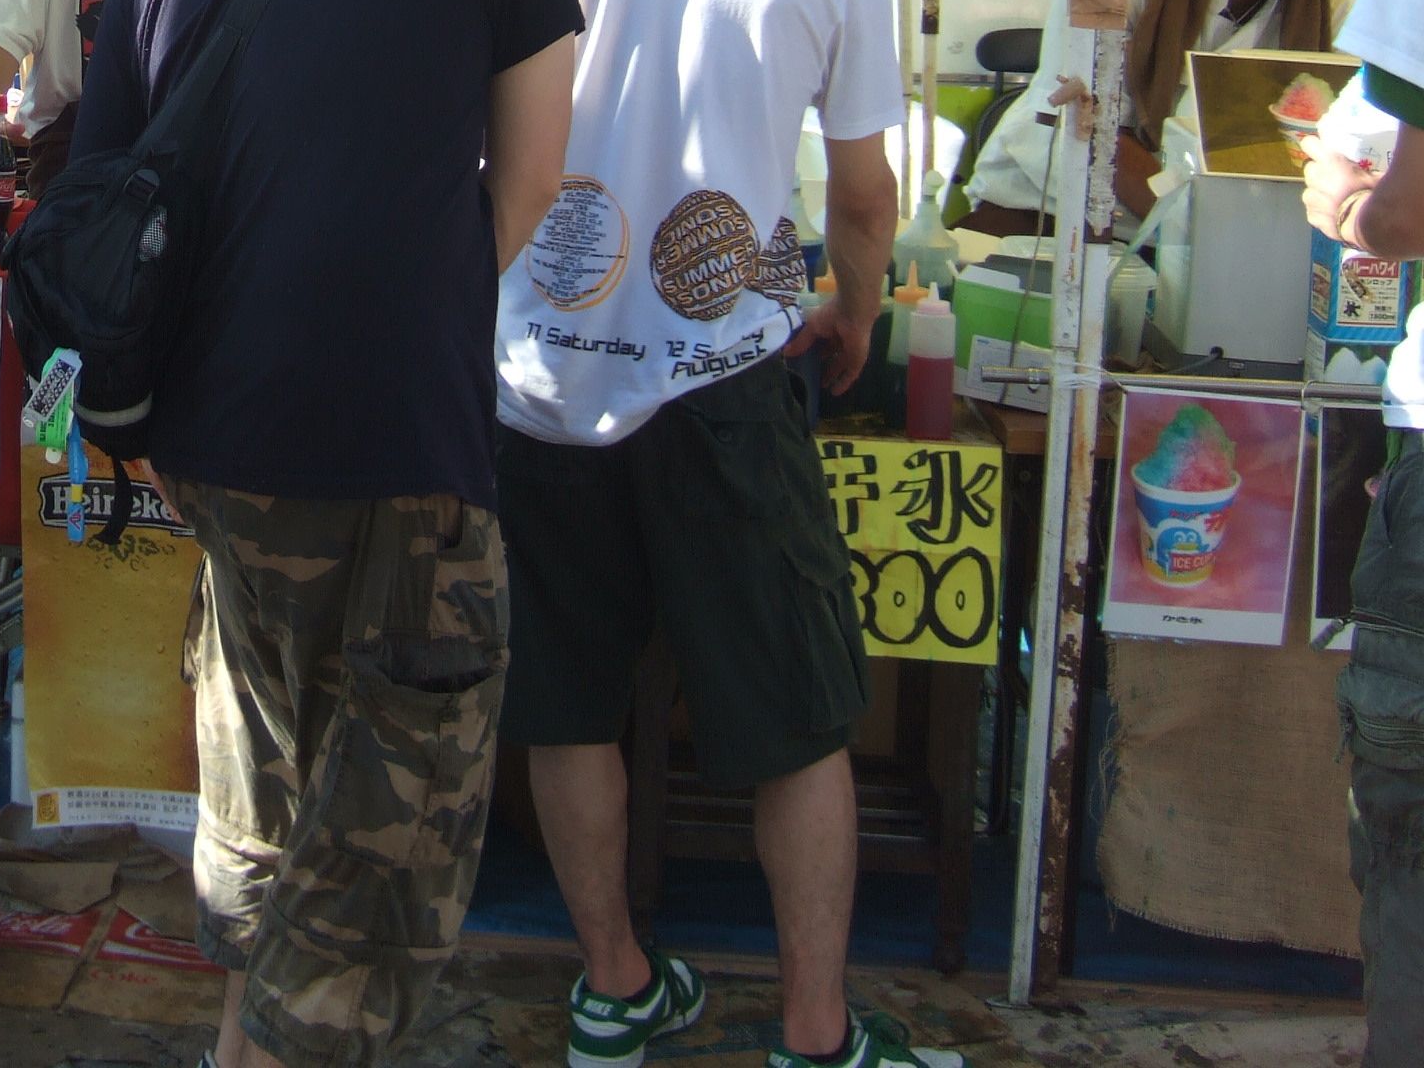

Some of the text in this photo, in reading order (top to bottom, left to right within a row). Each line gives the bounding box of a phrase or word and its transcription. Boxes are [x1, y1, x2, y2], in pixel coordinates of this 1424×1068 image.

[662, 241, 756, 294] SUMMER
[544, 327, 647, 362] Saturday
[670, 344, 768, 381] August
[1162, 614, 1203, 625] かき氷
